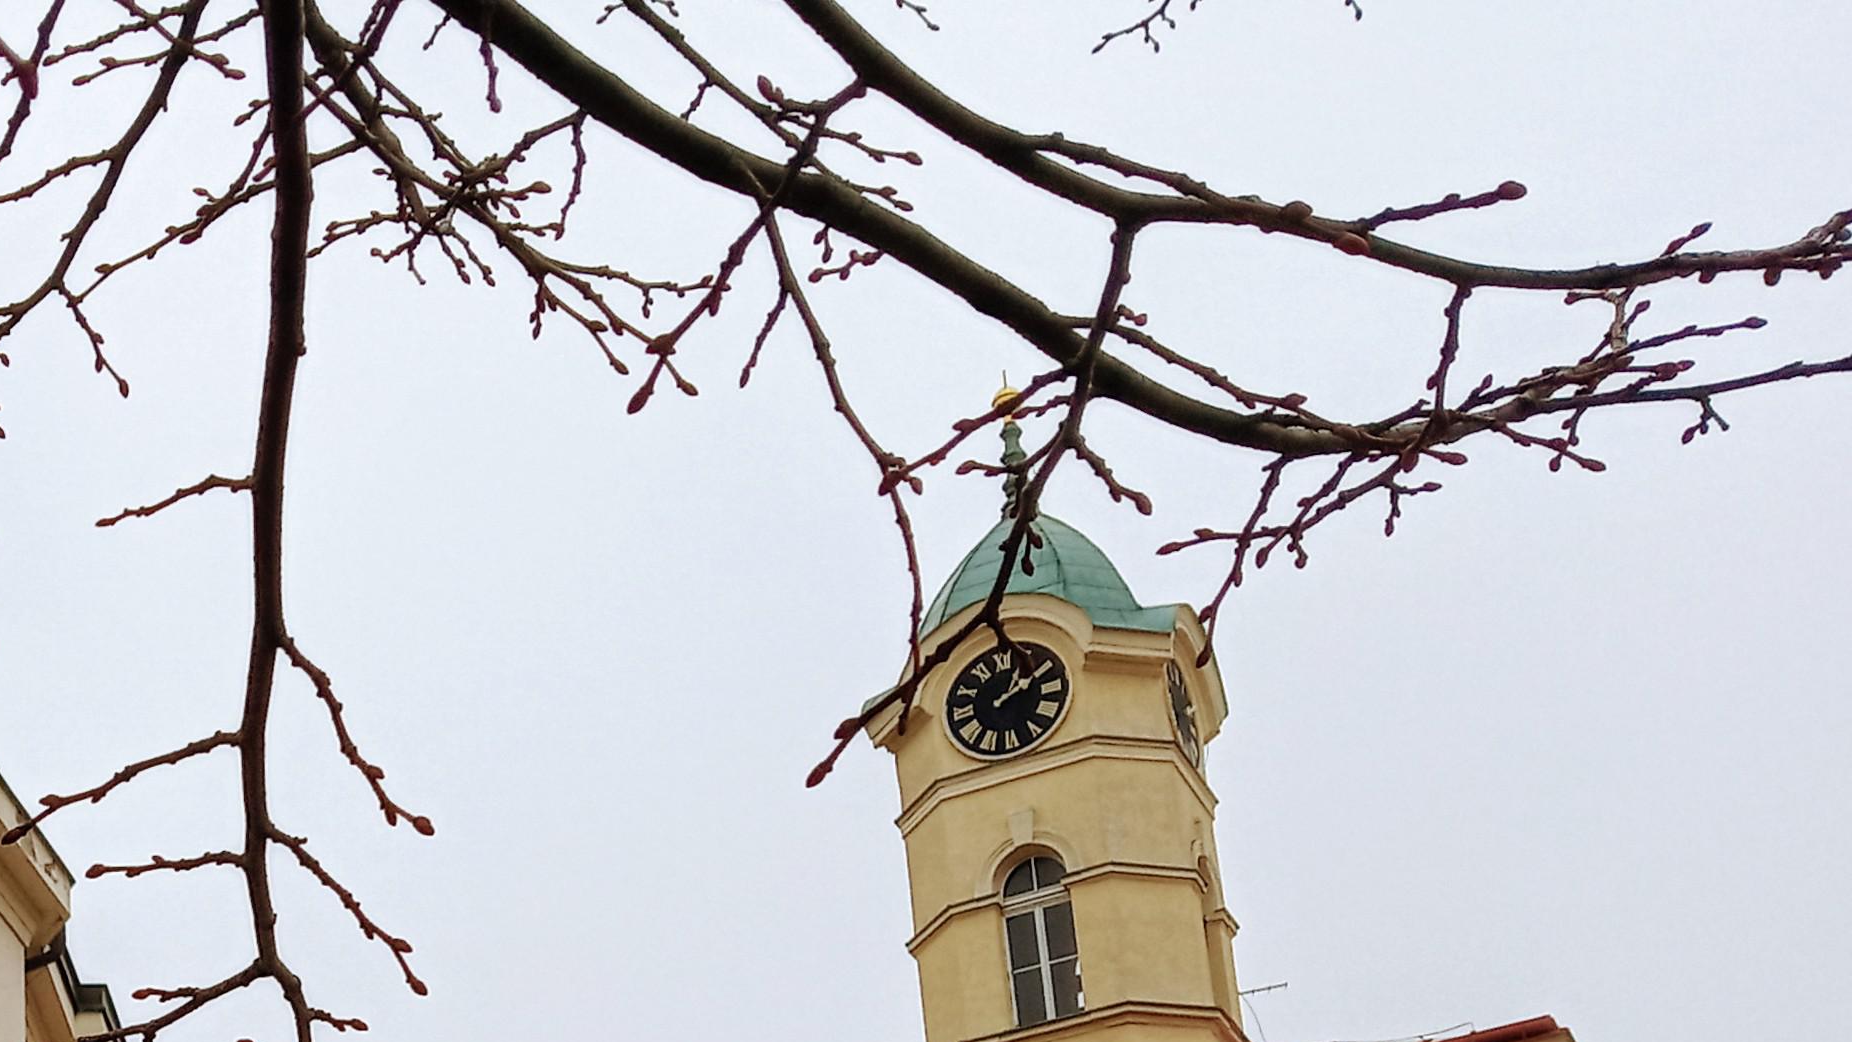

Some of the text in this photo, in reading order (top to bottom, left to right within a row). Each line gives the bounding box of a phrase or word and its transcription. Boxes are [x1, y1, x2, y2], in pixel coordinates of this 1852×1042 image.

[970, 662, 992, 683] XI
[956, 684, 977, 698] X
[1027, 720, 1043, 738] V
